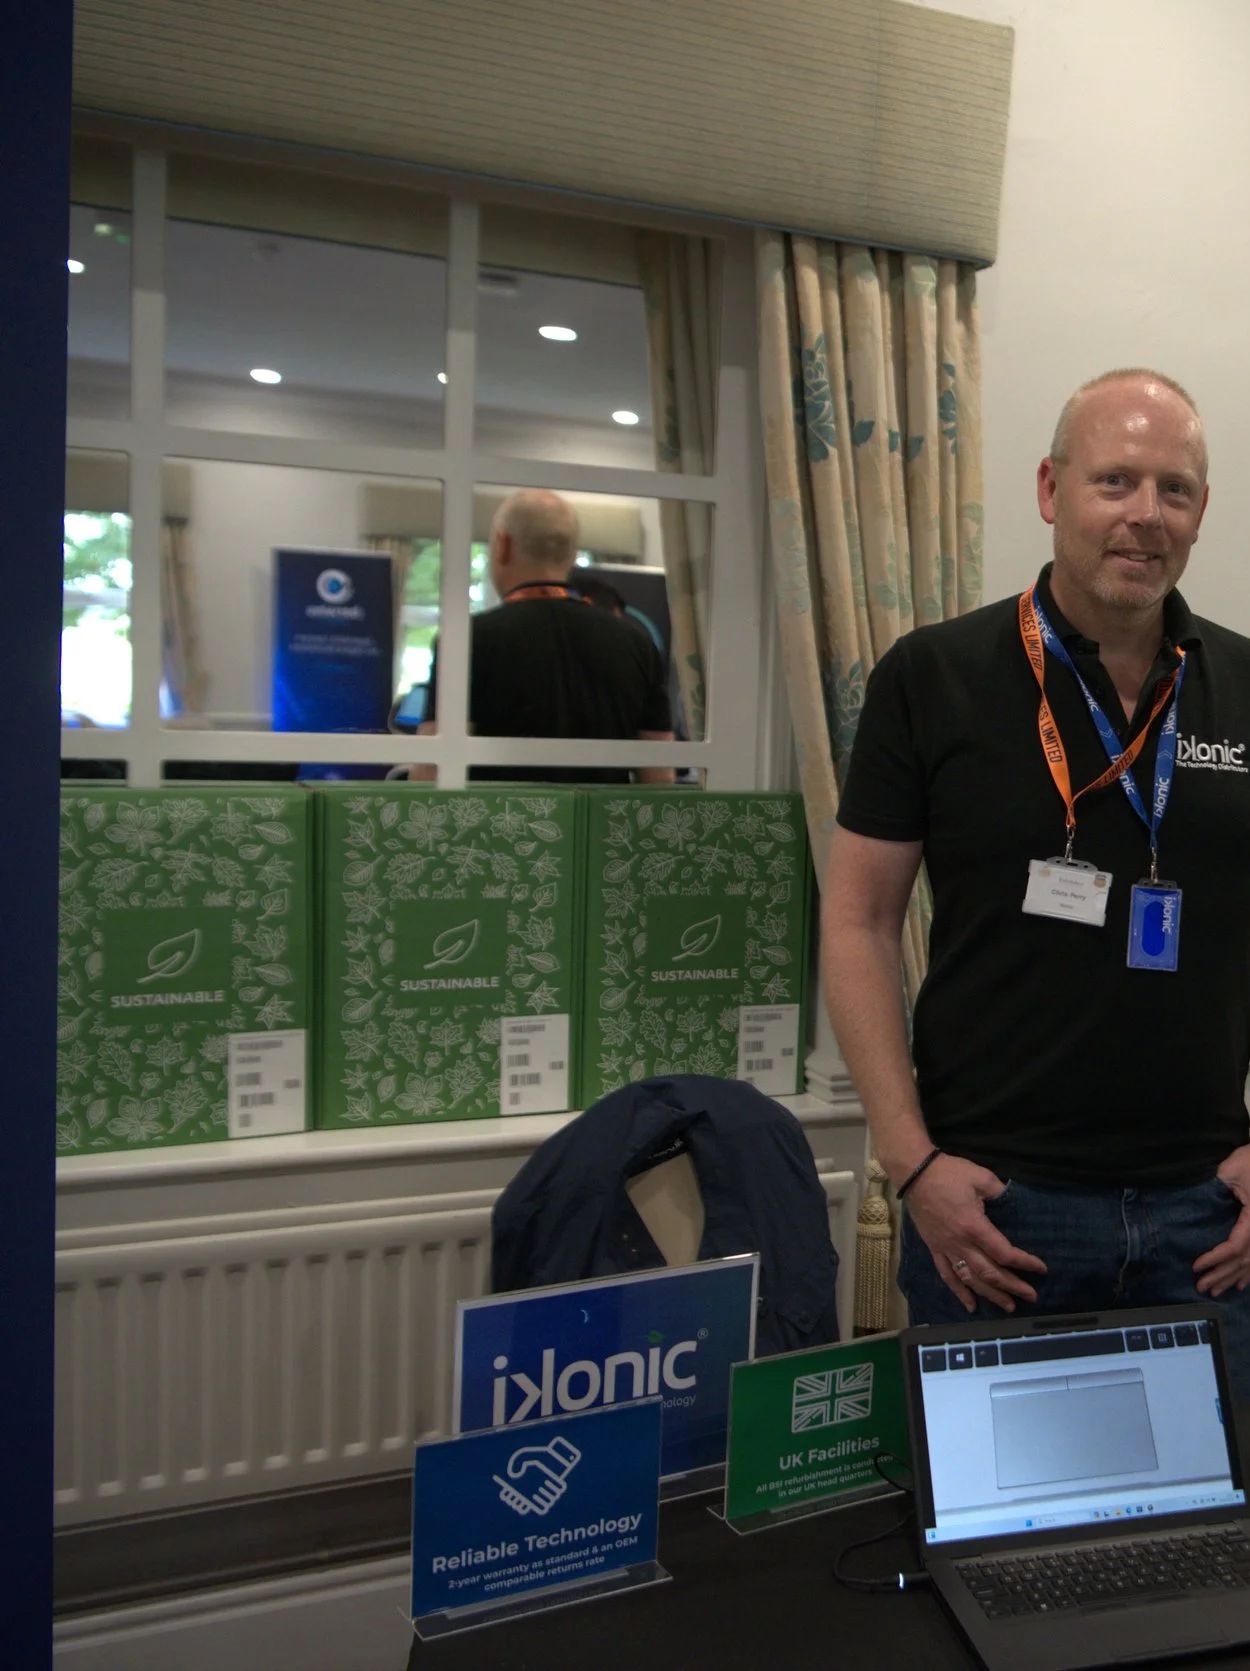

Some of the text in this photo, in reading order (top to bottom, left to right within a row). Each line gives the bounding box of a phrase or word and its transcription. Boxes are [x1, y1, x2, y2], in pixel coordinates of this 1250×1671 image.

[1040, 721, 1063, 763] LIMITED
[1154, 777, 1170, 819] ikonic
[1162, 896, 1177, 935] ikonic
[400, 975, 499, 992] SUSTAINABLE
[651, 968, 740, 982] SUSTAINABLE
[110, 990, 225, 1009] SUSTAINABLE
[779, 1436, 880, 1471] UK Facilities
[755, 1481, 767, 1494] All
[768, 1478, 783, 1490] BSI
[784, 1465, 842, 1486] refurbishment
[843, 1463, 850, 1472] is
[778, 1468, 873, 1498] in our UK head quarters
[432, 1512, 642, 1574] Reliable Technology
[448, 1574, 480, 1589] 2-year
[483, 1563, 530, 1581] warranty
[531, 1560, 543, 1569] as
[545, 1548, 590, 1566] standard
[600, 1543, 613, 1553] an
[615, 1536, 638, 1549] OEM
[484, 1555, 605, 1592] comparable returns rate
